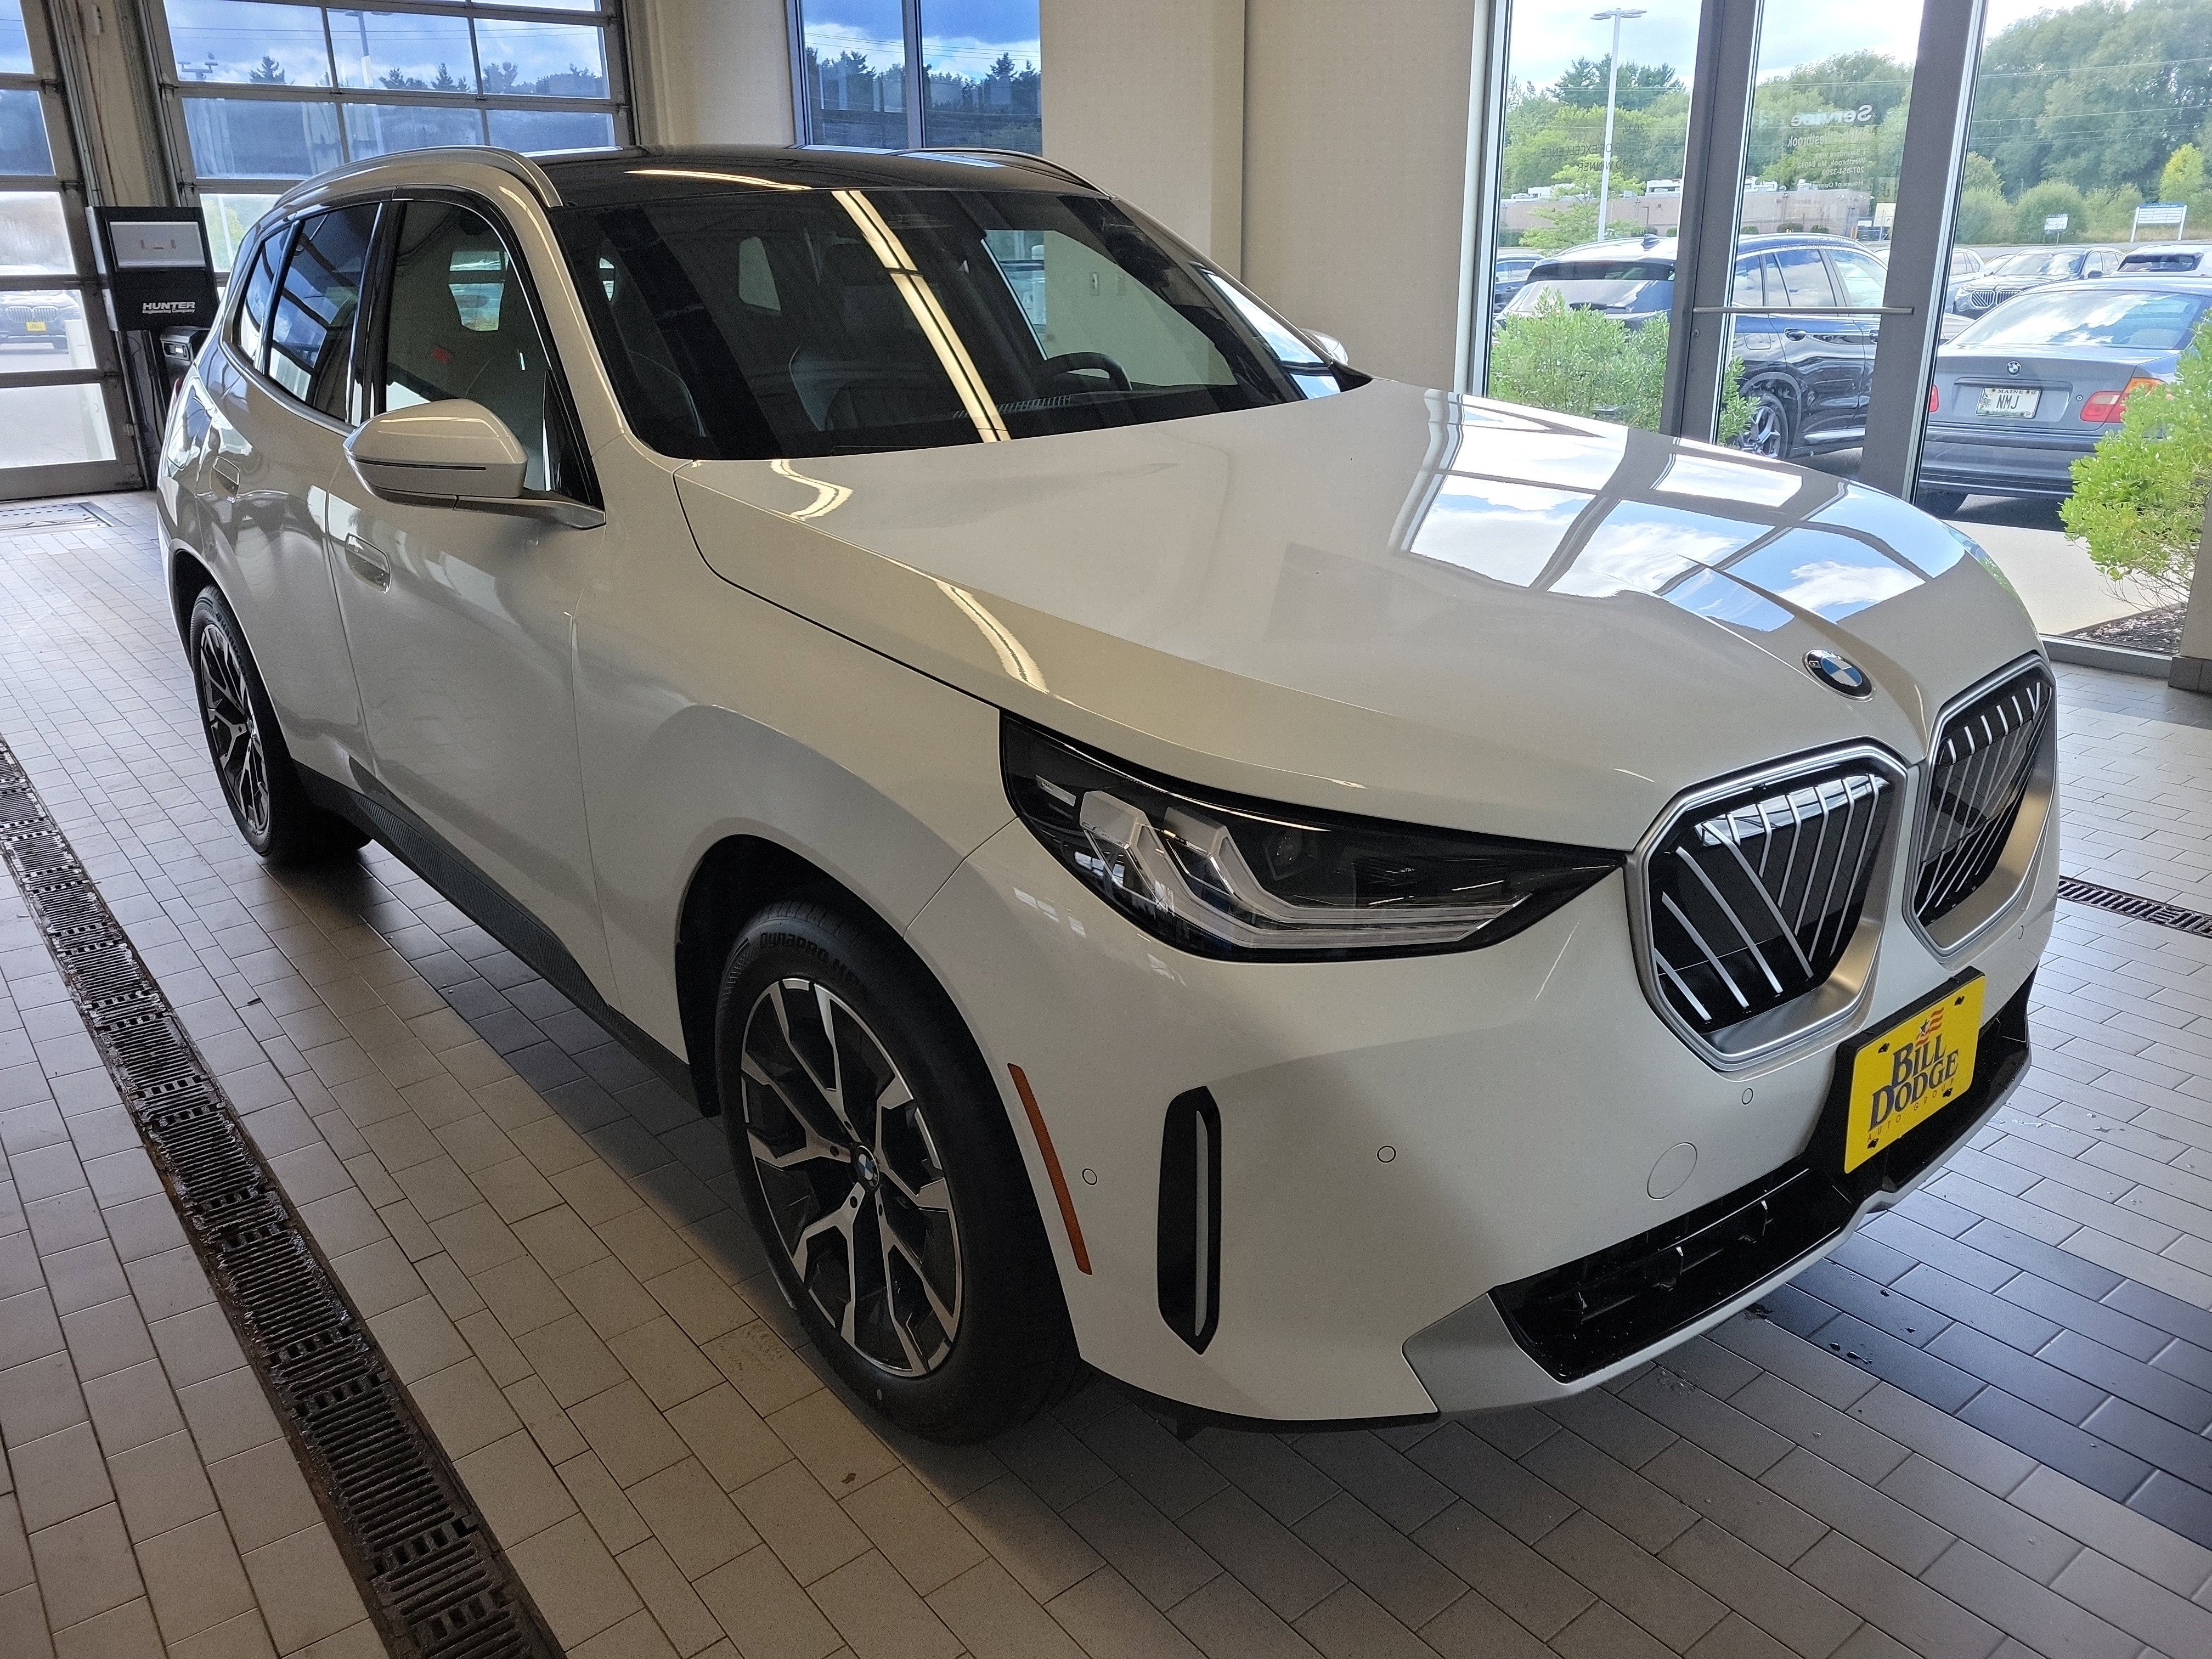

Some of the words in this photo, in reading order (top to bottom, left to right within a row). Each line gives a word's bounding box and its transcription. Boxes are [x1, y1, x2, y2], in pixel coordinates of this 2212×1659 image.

[1996, 394, 2019, 409] NMJ
[1891, 1033, 1946, 1087] BILL
[1867, 1048, 1960, 1132] DODGE
[1867, 1114, 1901, 1142] AUTO
[1913, 1077, 1954, 1111] GROUP
